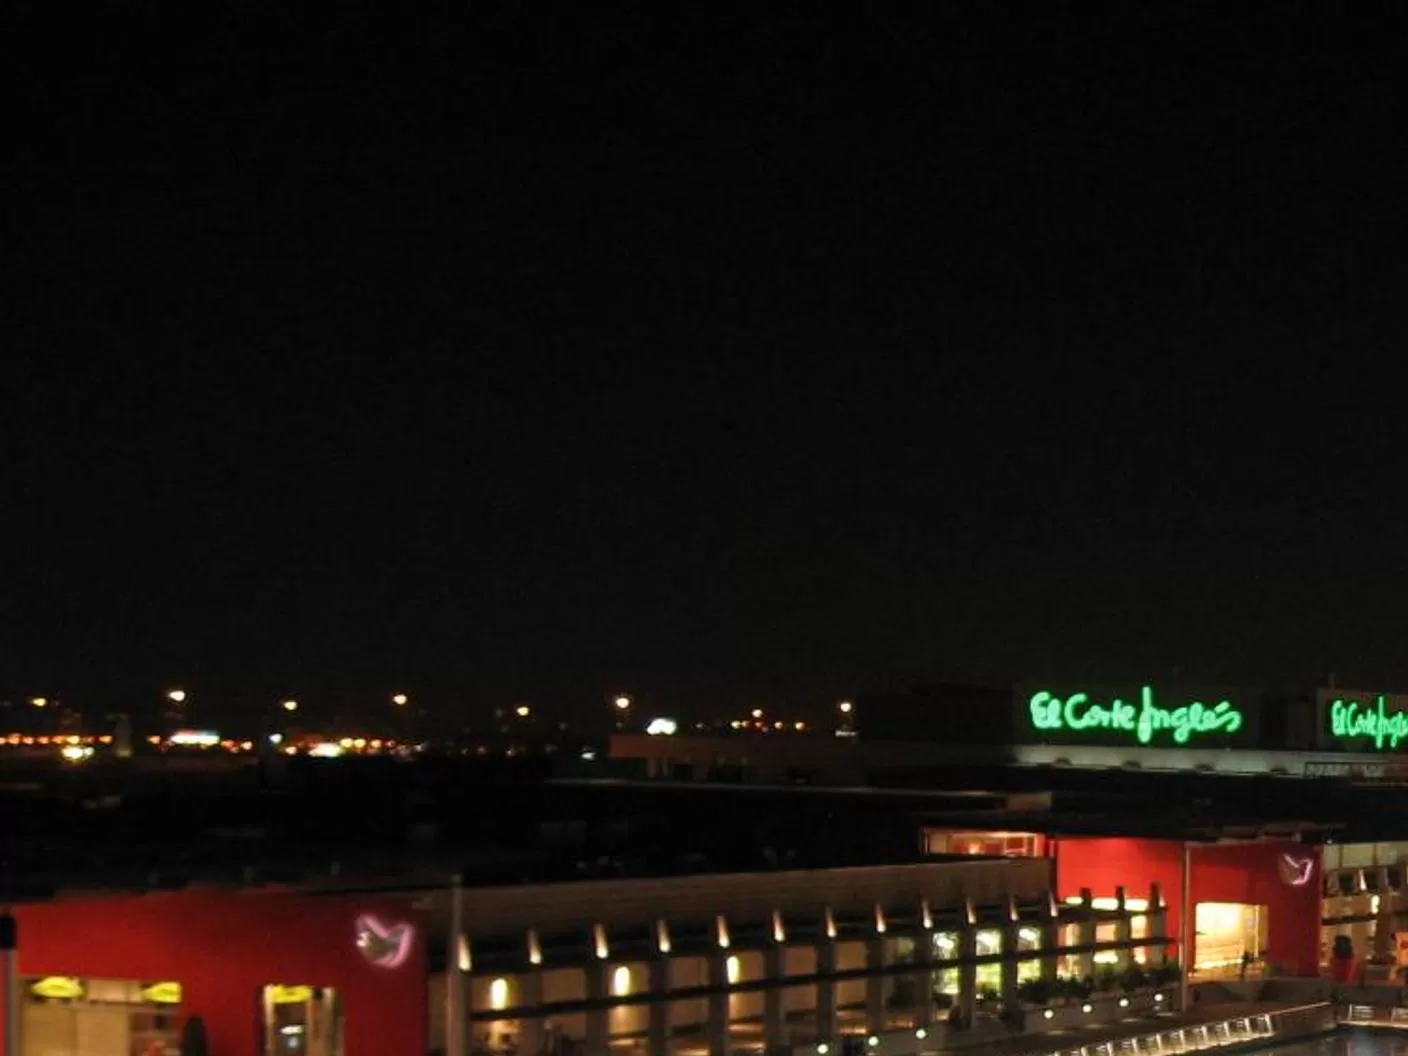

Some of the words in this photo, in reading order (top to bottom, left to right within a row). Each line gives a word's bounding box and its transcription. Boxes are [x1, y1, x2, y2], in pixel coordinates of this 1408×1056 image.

[1031, 692, 1062, 729] El
[1065, 693, 1135, 729] Corte
[1137, 686, 1241, 743] Inglés
[1332, 700, 1346, 736] El
